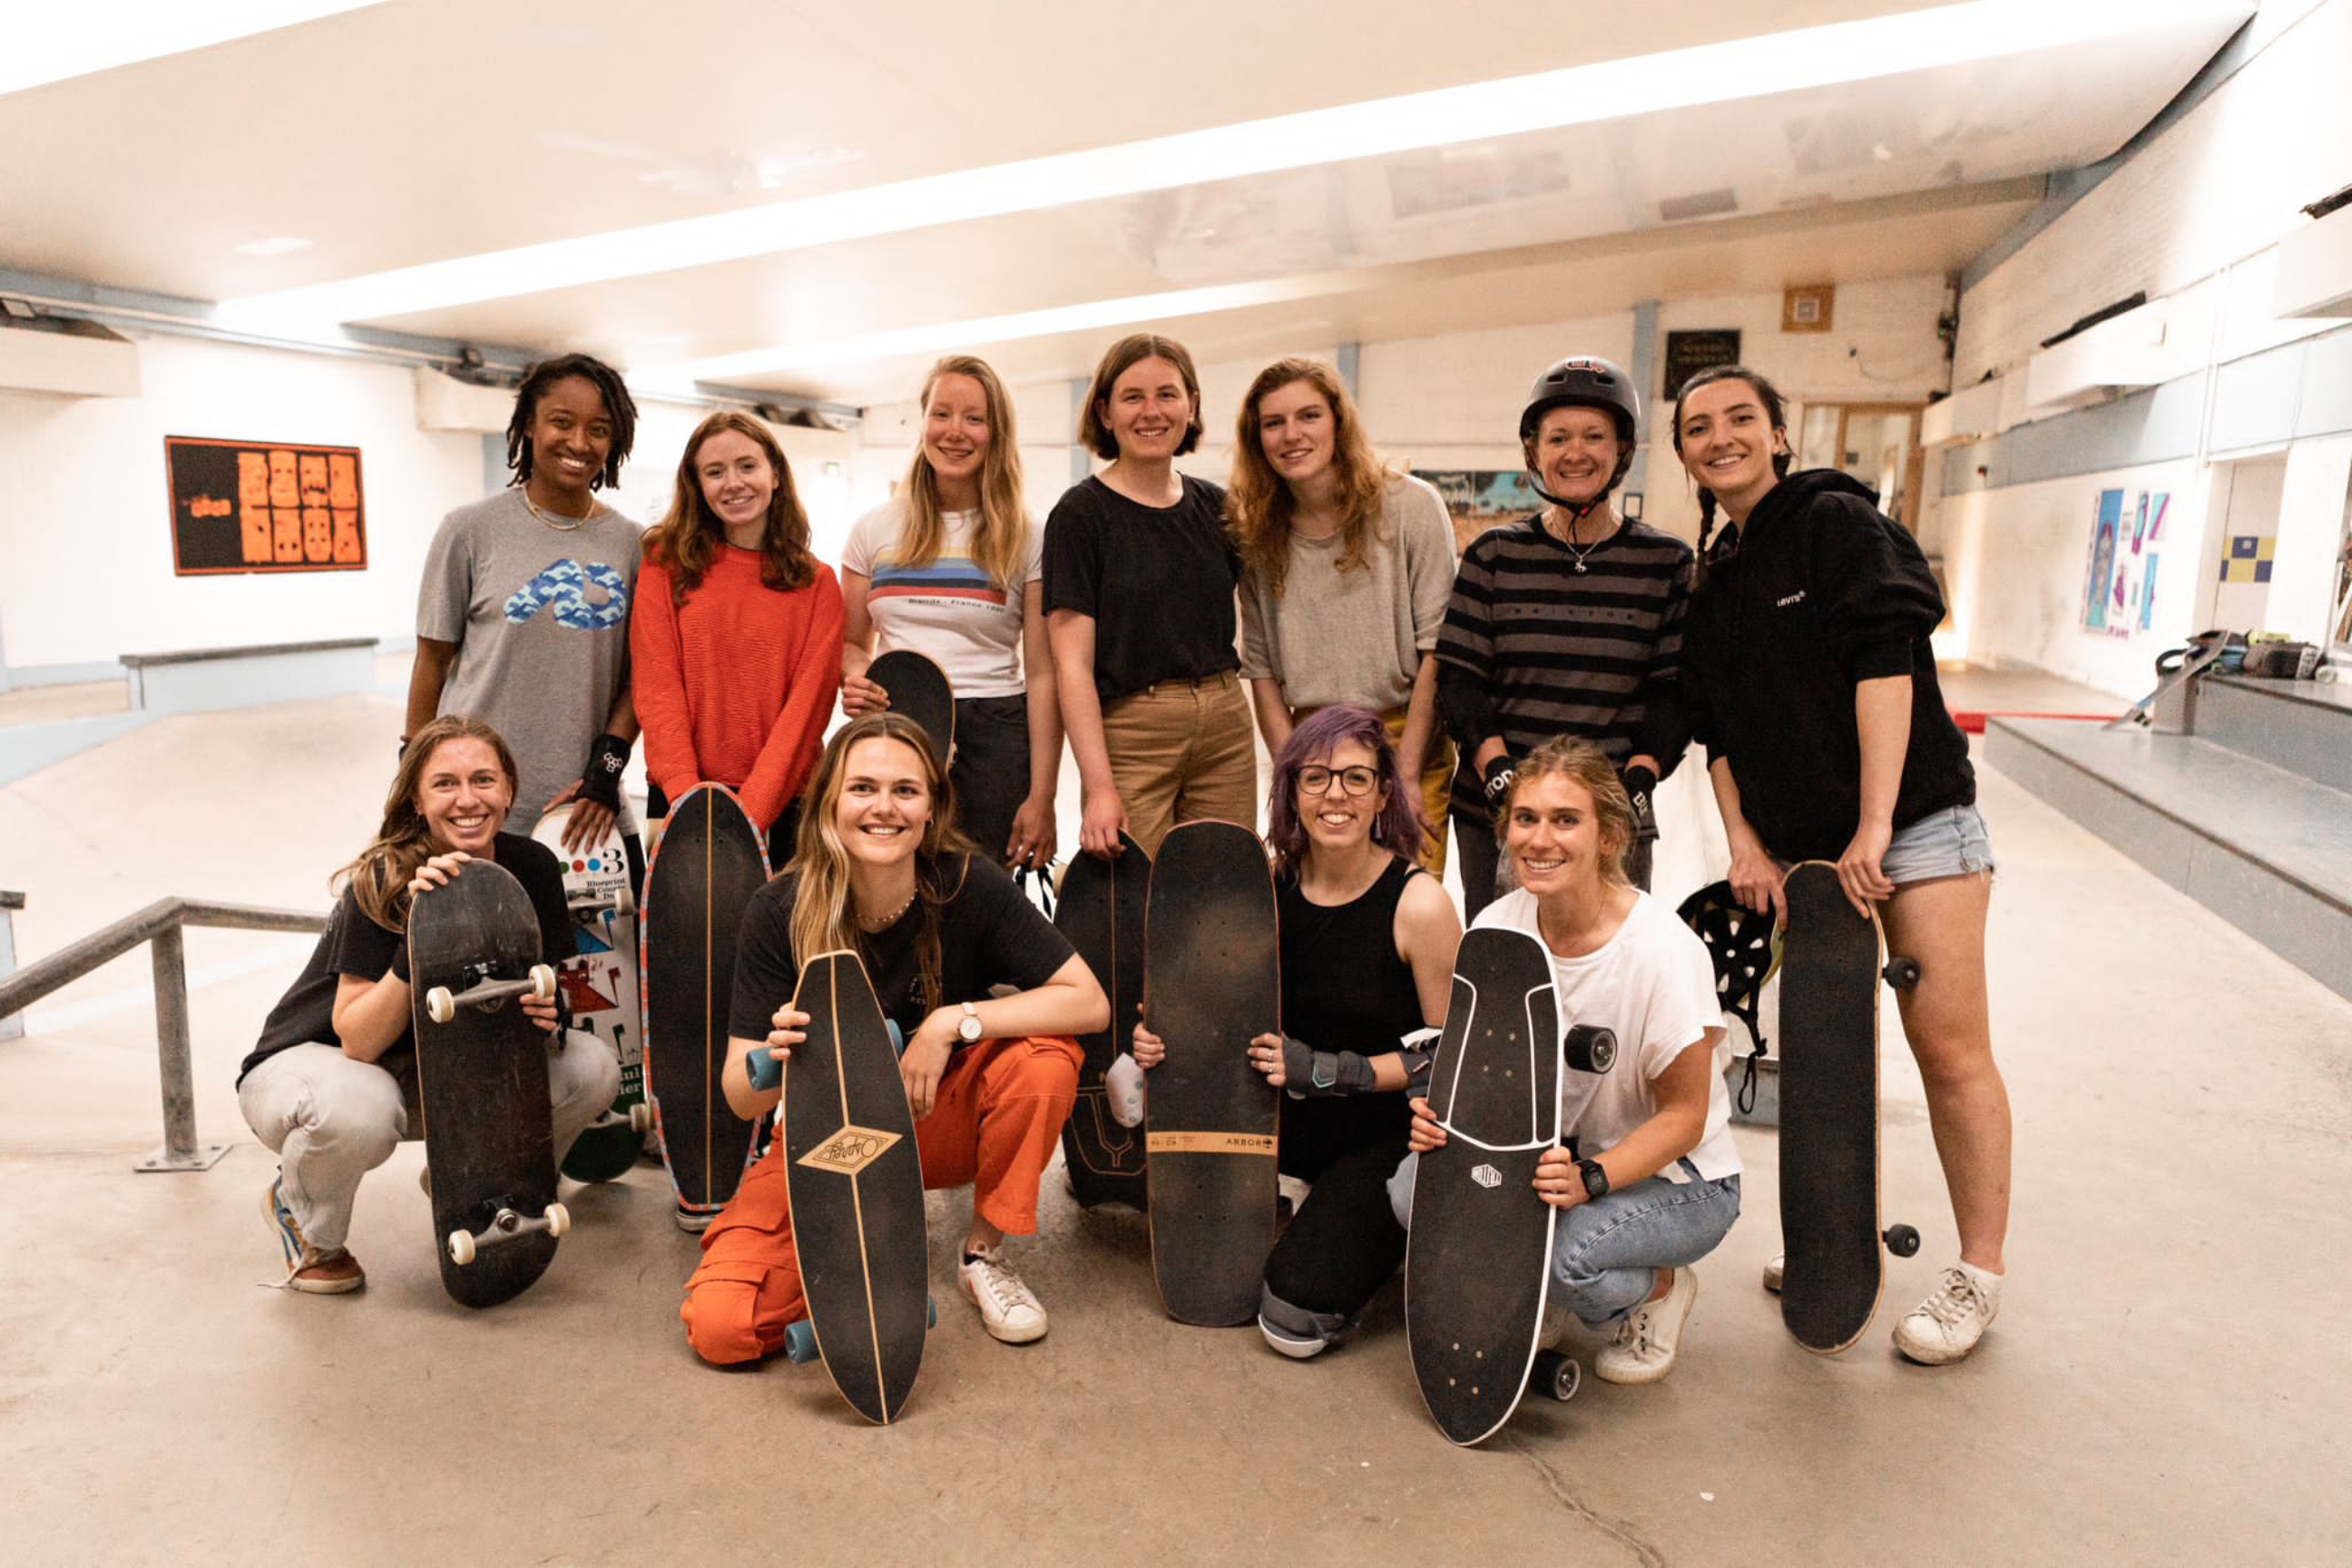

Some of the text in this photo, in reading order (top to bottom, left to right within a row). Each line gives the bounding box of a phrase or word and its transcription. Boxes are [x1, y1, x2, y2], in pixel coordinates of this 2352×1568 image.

[603, 848, 624, 875] 3
[586, 877, 626, 887] Blueprint
[1226, 1138, 1261, 1147] ARBOR
